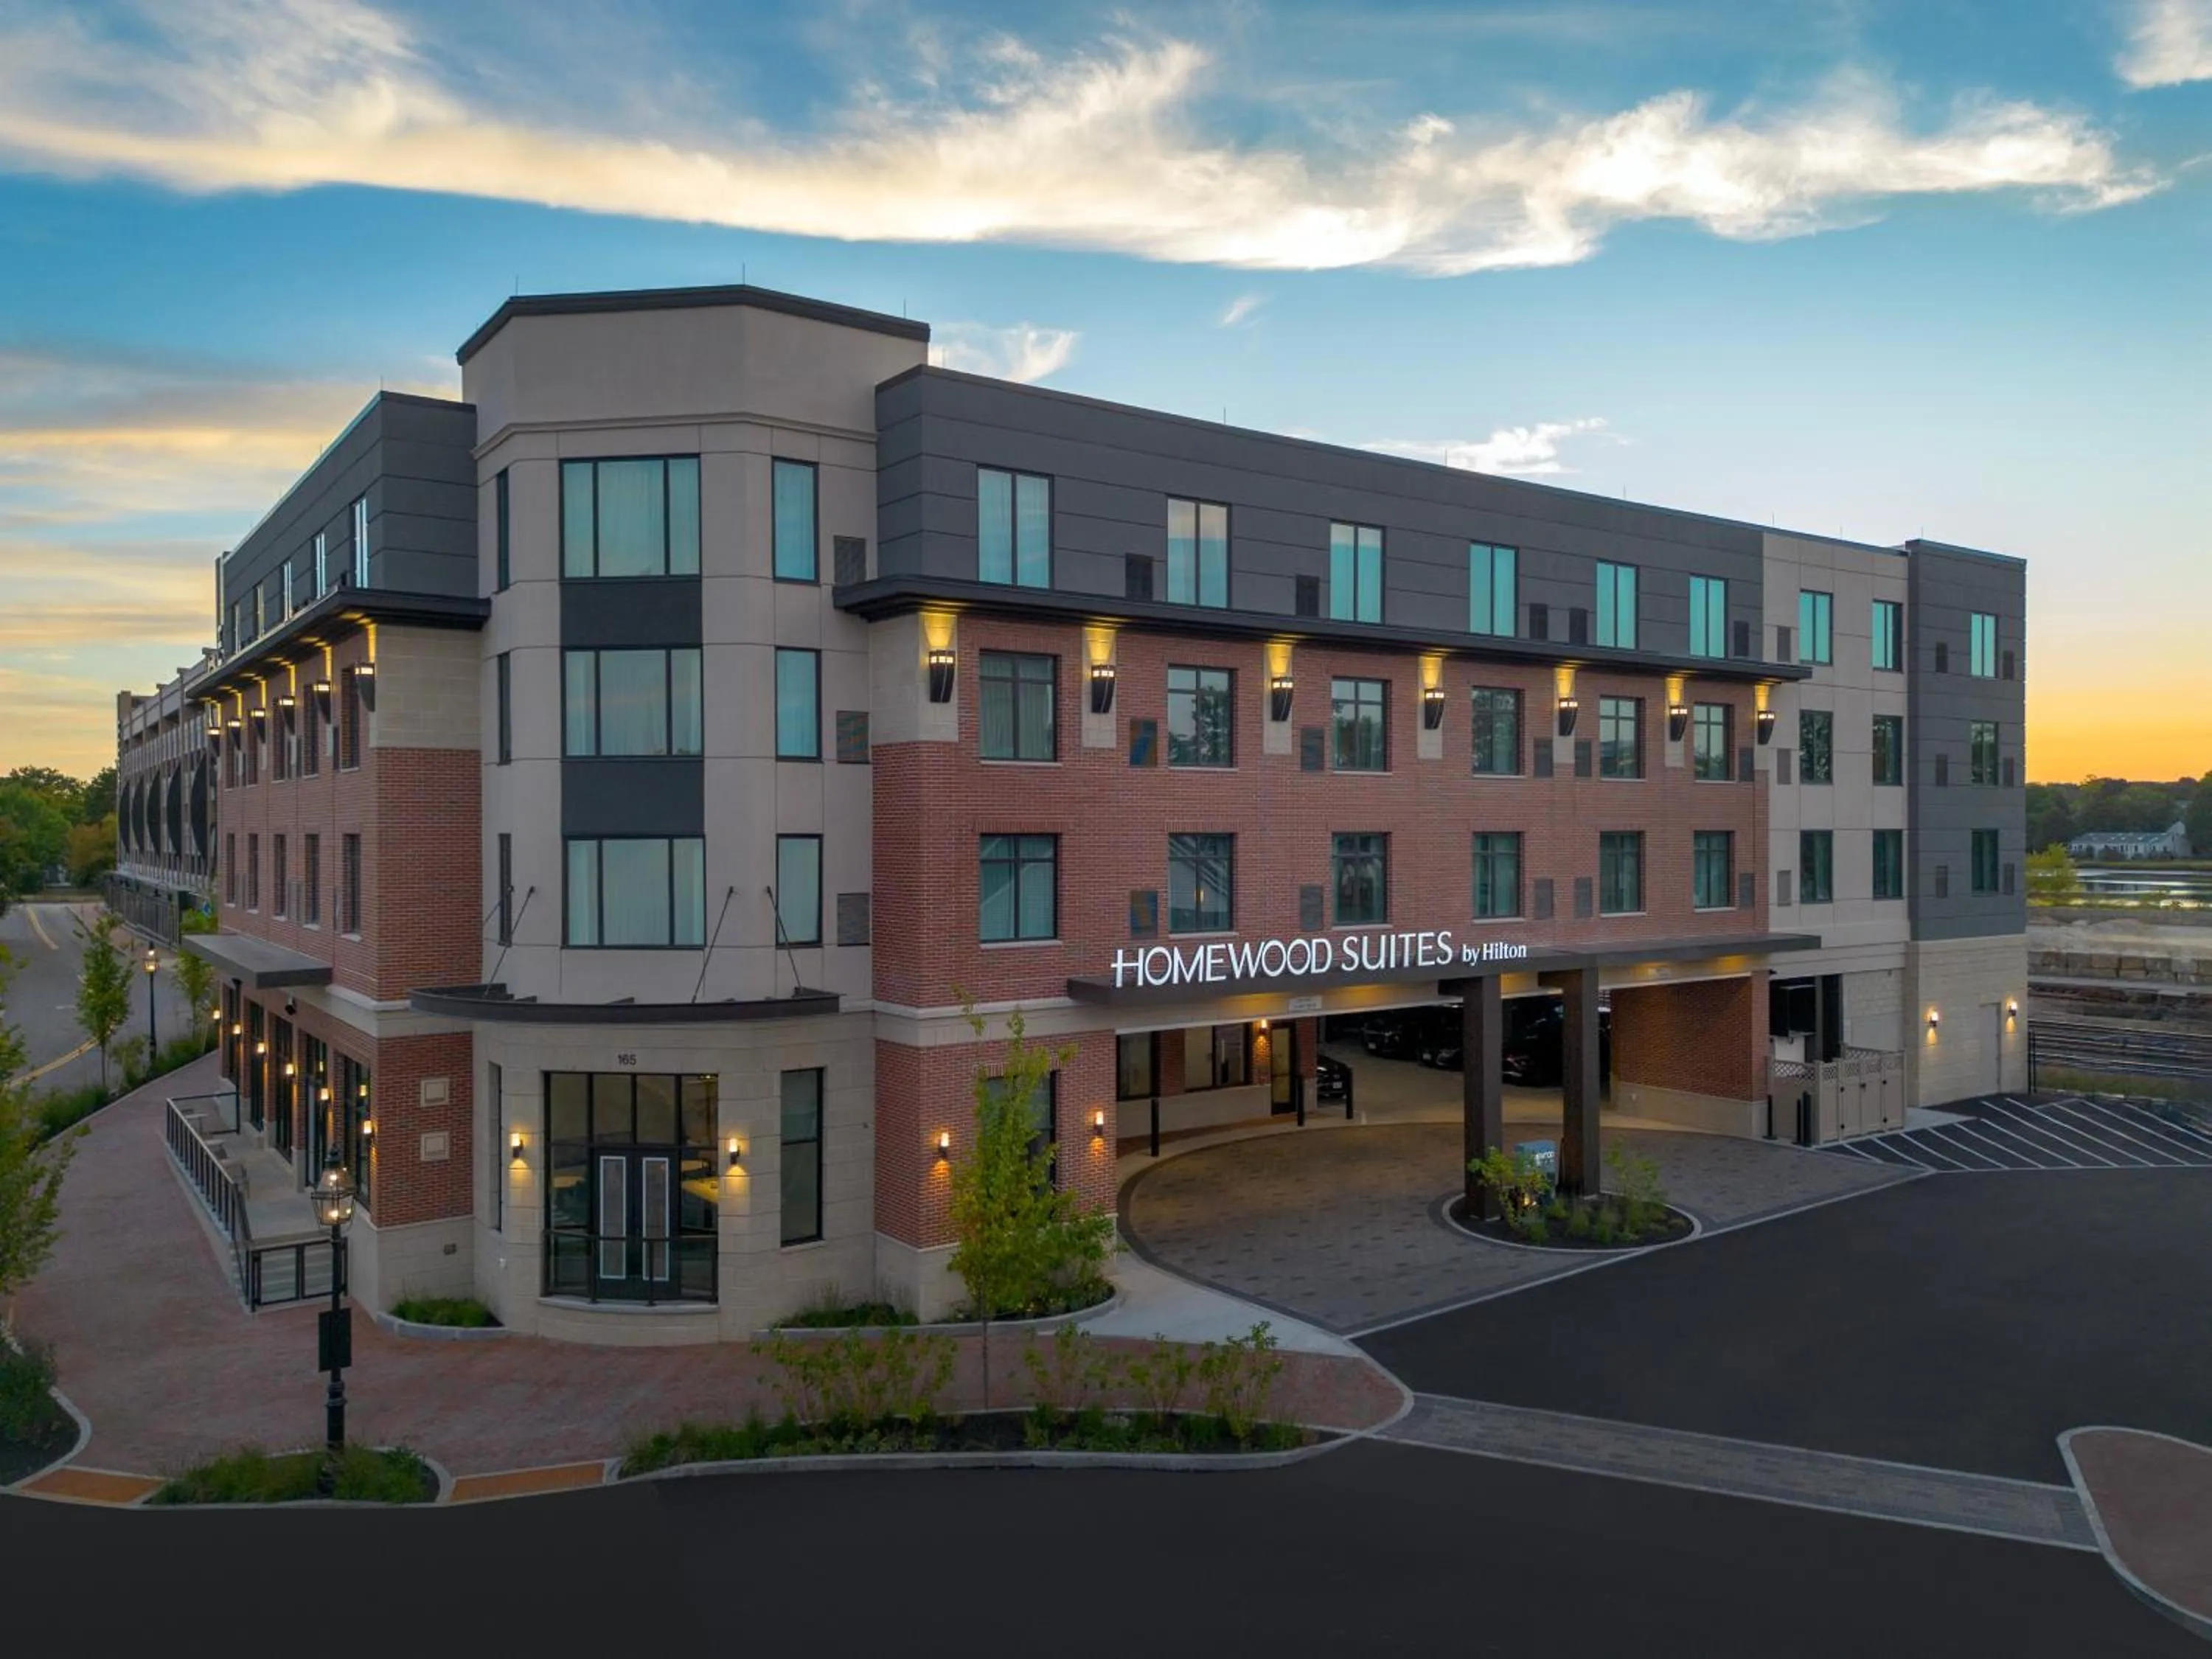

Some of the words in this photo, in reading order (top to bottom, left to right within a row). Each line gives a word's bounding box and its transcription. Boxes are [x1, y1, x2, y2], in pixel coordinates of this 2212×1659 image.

[1110, 938, 1332, 988] HOMEWOOD
[1341, 931, 1453, 972] SUITES
[1462, 944, 1480, 967] by
[1482, 942, 1527, 961] Hilton
[618, 1054, 637, 1066] 165
